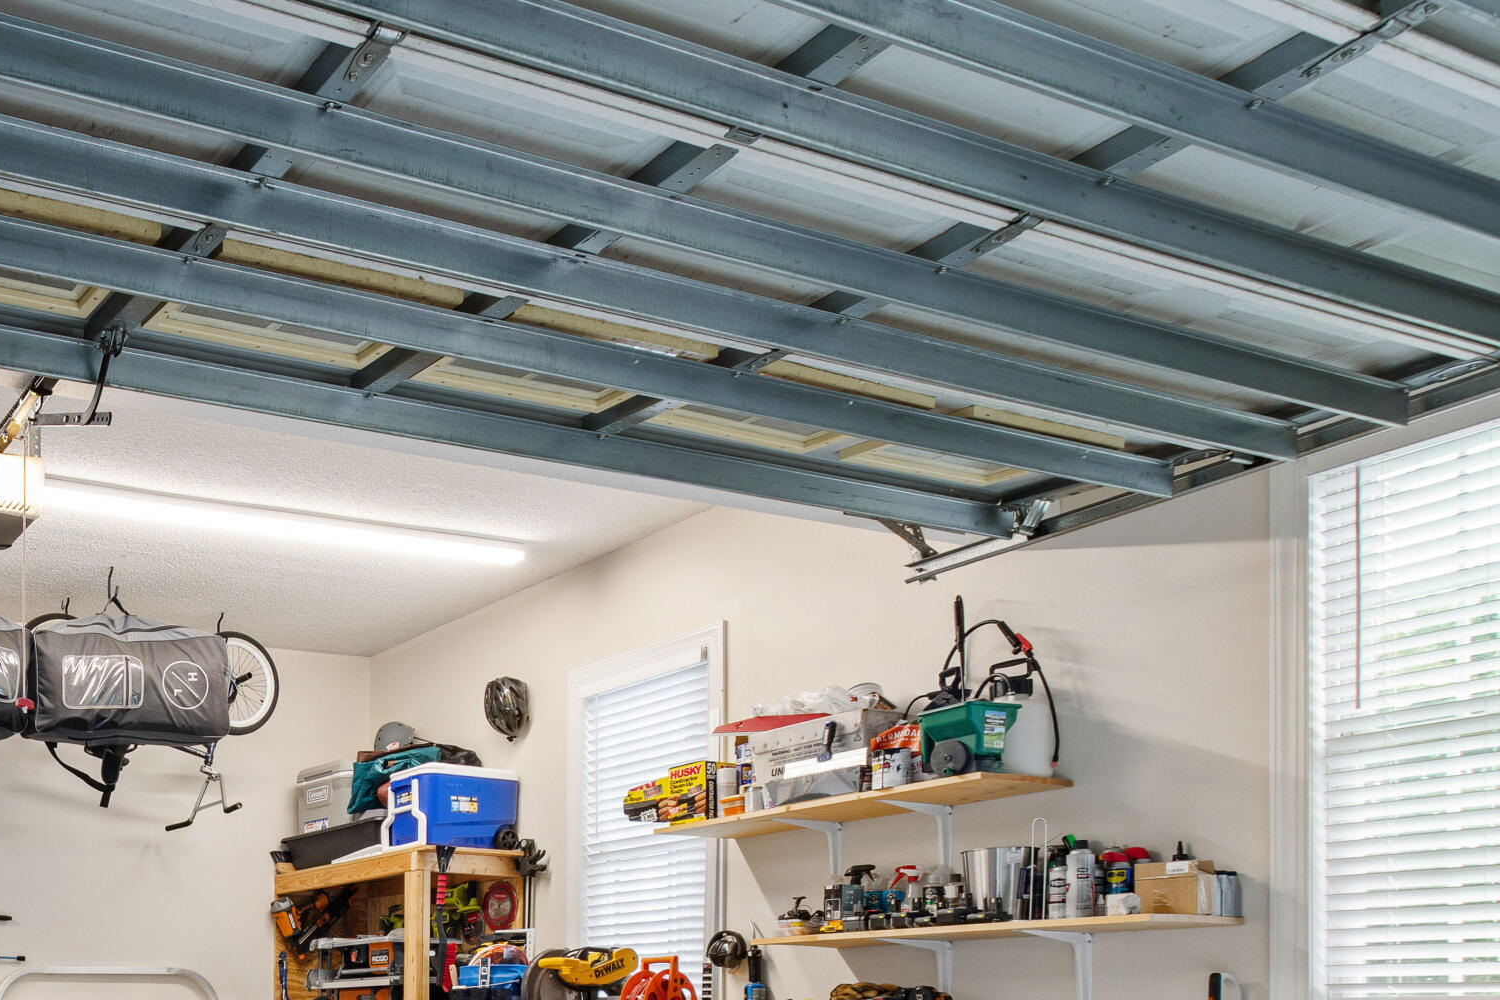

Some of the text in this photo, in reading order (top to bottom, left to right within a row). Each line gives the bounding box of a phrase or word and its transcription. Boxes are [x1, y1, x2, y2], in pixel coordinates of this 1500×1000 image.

[670, 764, 702, 780] HUSKY
[706, 763, 717, 775] 50
[771, 767, 784, 777] UN
